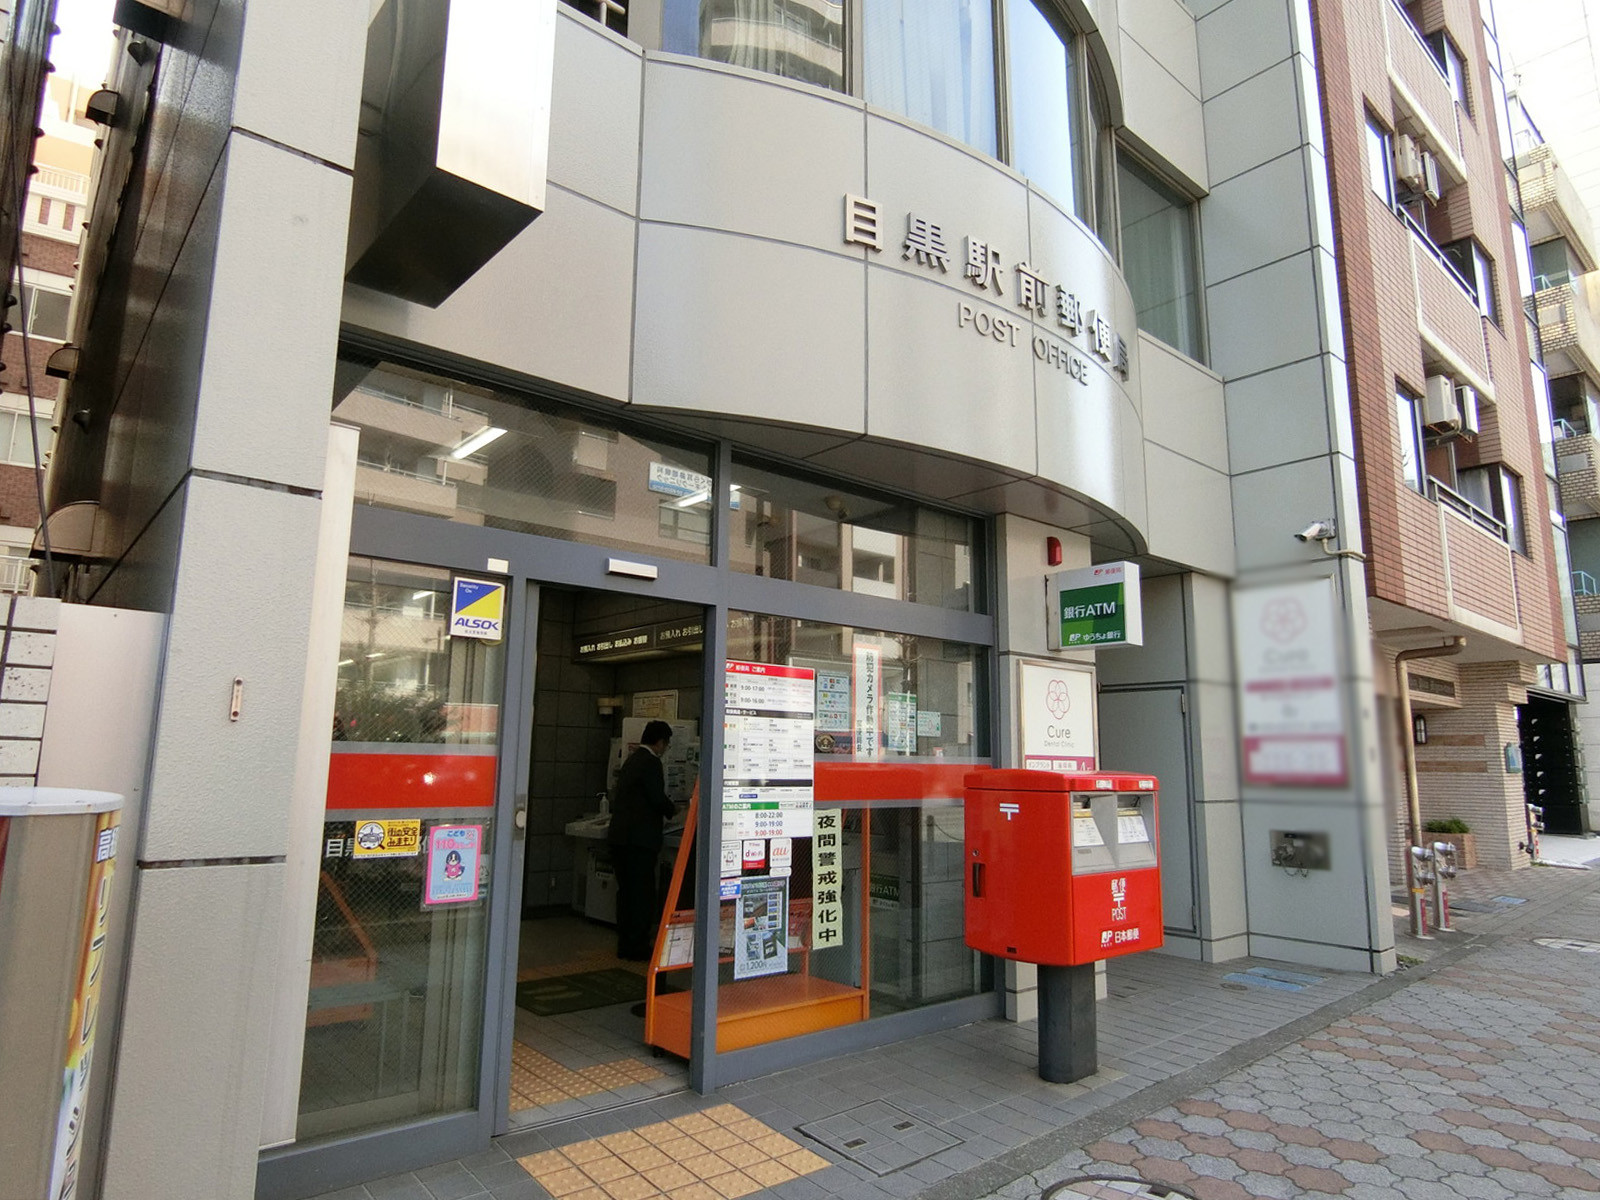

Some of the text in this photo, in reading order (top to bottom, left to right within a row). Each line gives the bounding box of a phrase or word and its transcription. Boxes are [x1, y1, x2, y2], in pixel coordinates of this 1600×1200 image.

[958, 302, 1089, 386] POST OFFICE
[1064, 602, 1116, 619] 銀行ATM
[455, 617, 499, 631] ALSOK
[1082, 630, 1121, 642] ゆうちょ銀行
[1047, 725, 1071, 739] Cure
[773, 847, 788, 856] au
[817, 815, 838, 942] 夜間警戒強化中
[1111, 878, 1126, 895] 郵便
[1111, 907, 1126, 921] POST
[1114, 928, 1140, 944] 日本郵便
